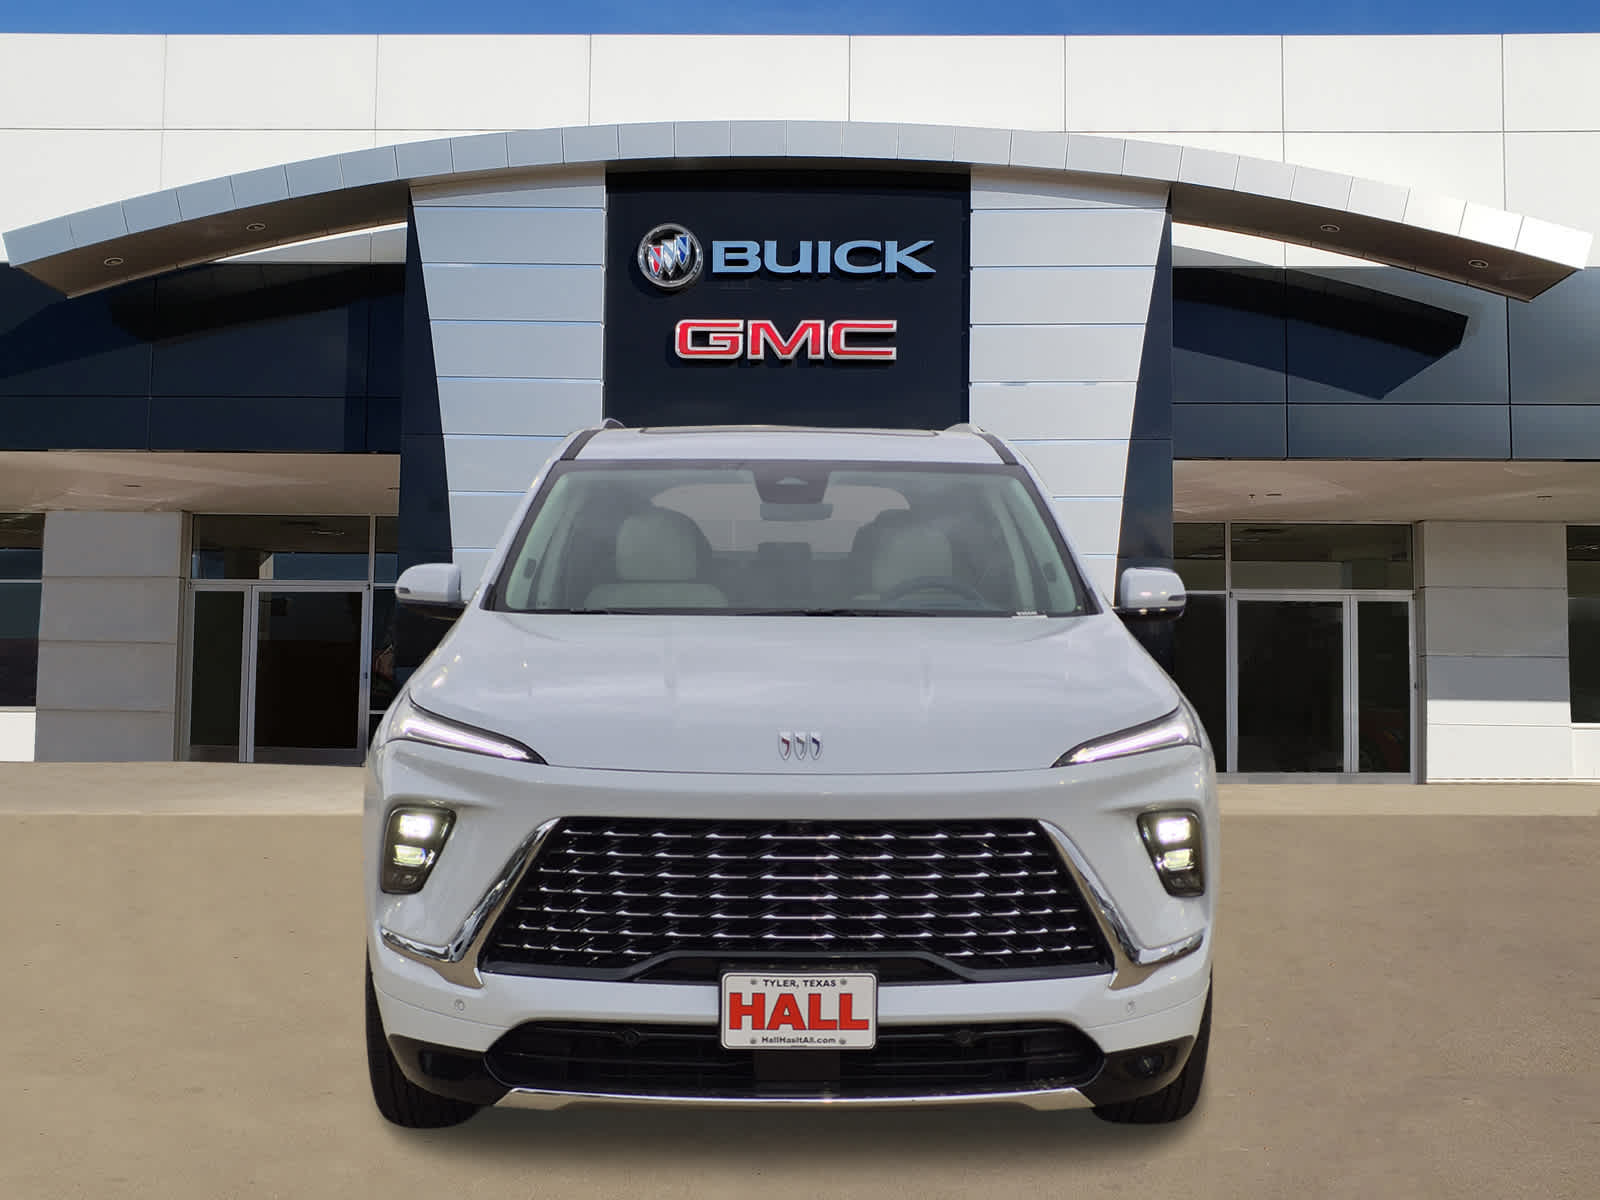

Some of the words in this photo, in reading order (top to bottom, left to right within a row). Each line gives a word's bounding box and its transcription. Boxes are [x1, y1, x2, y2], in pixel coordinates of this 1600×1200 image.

[712, 240, 936, 273] BUICK
[675, 319, 897, 360] GMC
[763, 979, 799, 988] TYLER,
[803, 979, 836, 987] TEXAS
[729, 992, 869, 1030] HALL
[761, 1036, 836, 1044] HallHasItAll.com
